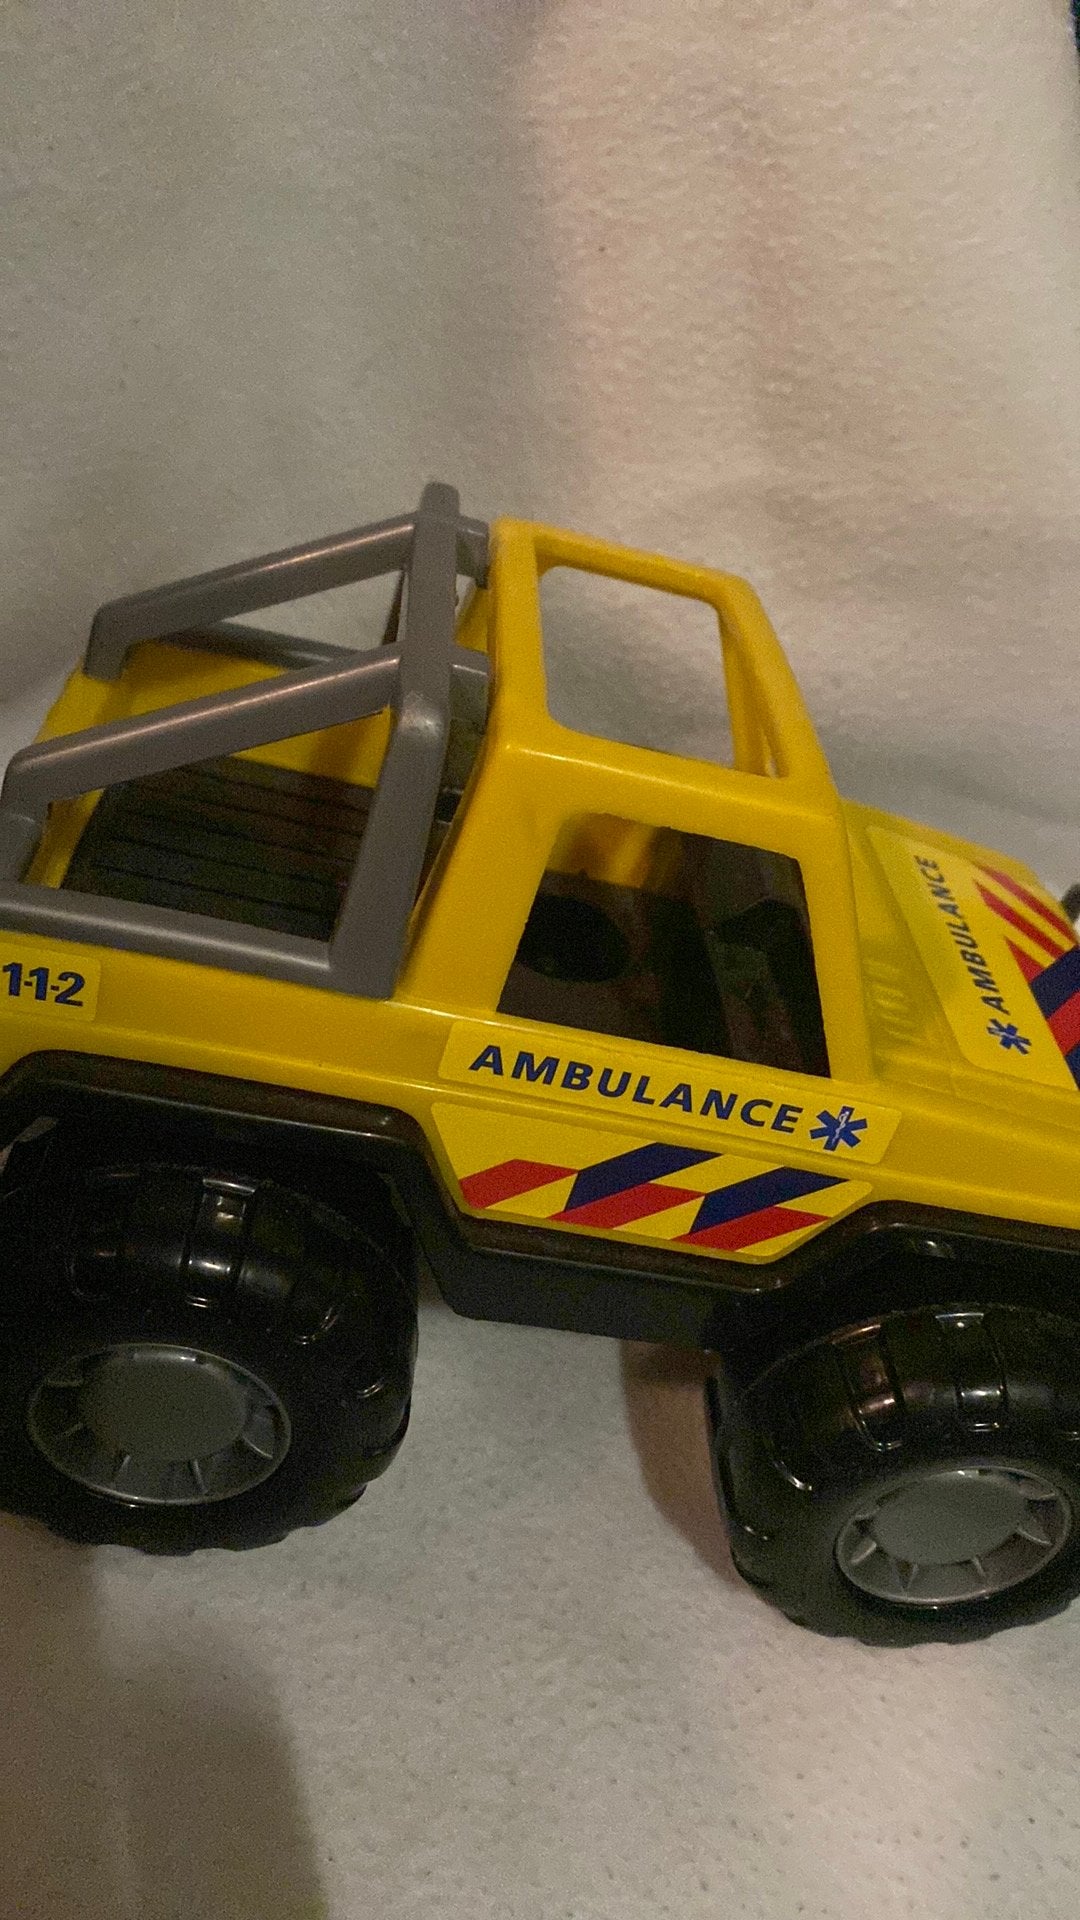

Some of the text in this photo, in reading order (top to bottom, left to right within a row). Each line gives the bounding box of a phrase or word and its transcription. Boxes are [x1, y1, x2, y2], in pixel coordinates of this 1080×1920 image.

[914, 855, 1010, 1016] AMBULANCE
[2, 962, 86, 1007] 1-1-2
[468, 1044, 804, 1134] AMBULANCE
